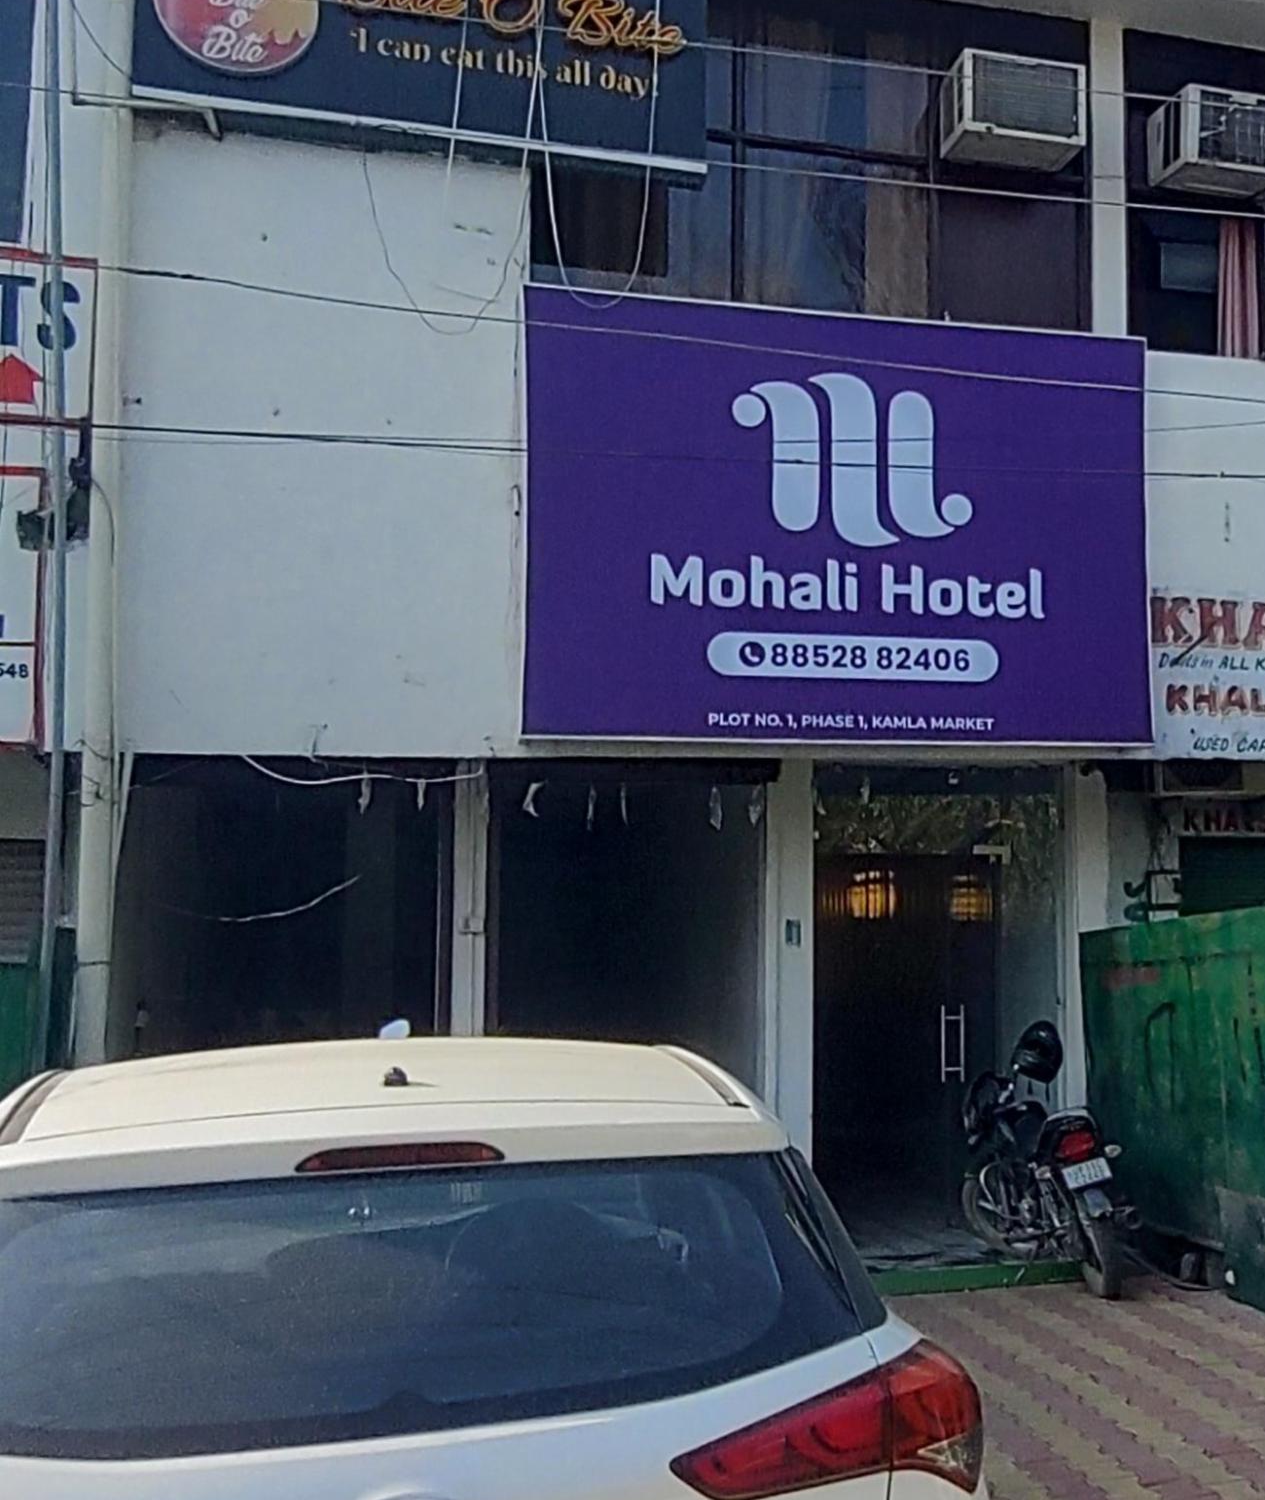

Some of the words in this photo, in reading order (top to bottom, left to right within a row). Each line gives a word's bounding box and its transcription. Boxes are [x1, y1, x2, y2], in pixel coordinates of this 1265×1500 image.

[202, 24, 269, 63] Bite
[376, 35, 431, 64] can
[440, 47, 485, 71] eat
[495, 49, 548, 81] this
[555, 60, 591, 88] all
[649, 552, 860, 613] Mohali
[880, 563, 1046, 620] Hotel
[770, 643, 868, 671] 88528
[875, 644, 971, 673] 82406
[1218, 656, 1250, 672] ALL
[707, 711, 750, 728] PLOT
[753, 712, 785, 728] NO.
[787, 713, 799, 730] 1,
[801, 713, 855, 729] PHASE
[857, 714, 869, 732] 1,
[871, 714, 928, 731] KAMLA
[930, 715, 995, 732] MARKET
[1192, 736, 1230, 752] USED
